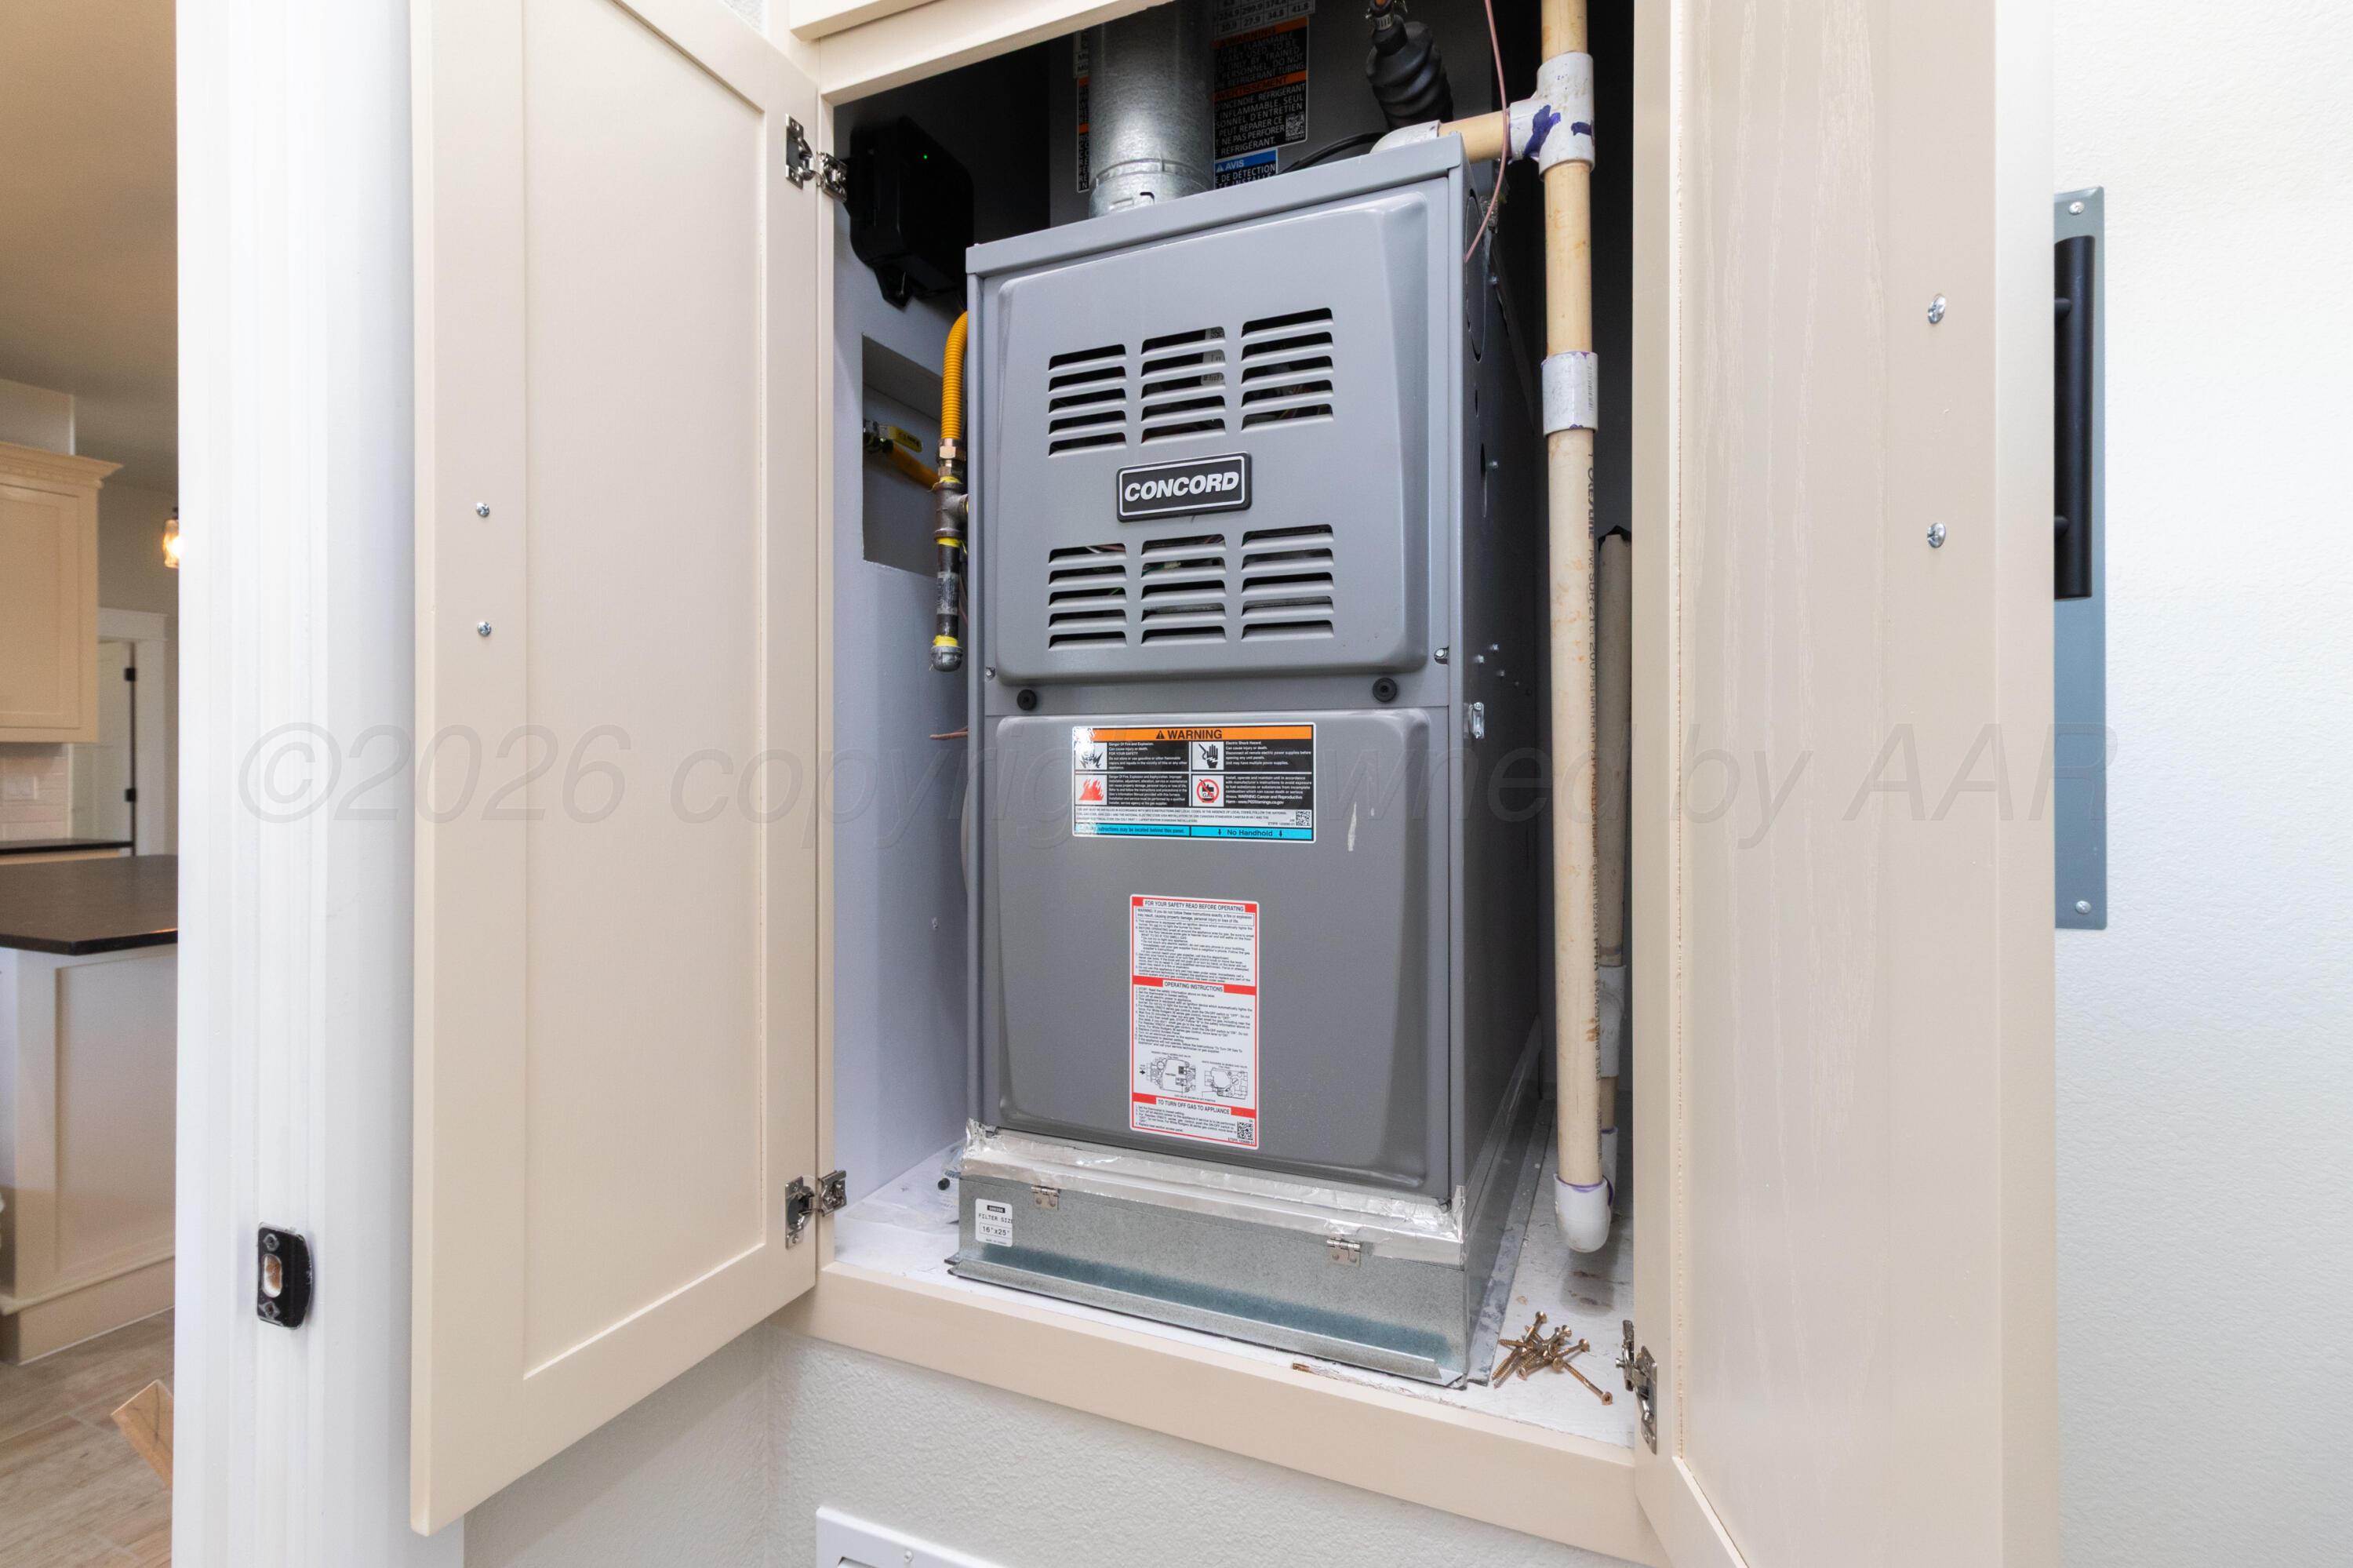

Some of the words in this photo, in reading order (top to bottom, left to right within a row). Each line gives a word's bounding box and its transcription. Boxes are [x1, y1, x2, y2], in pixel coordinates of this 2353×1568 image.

[1283, 92, 1304, 104] SEUL
[1273, 115, 1283, 125] CE
[1221, 137, 1232, 146] NE
[1232, 133, 1247, 142] PAS
[1247, 124, 1286, 140] PERFORER
[1225, 159, 1245, 170] AVIS
[1221, 173, 1231, 183] DE
[1232, 163, 1275, 180] DÉTECTION
[1125, 471, 1239, 502] CONCORD
[1168, 729, 1222, 740] WARNING
